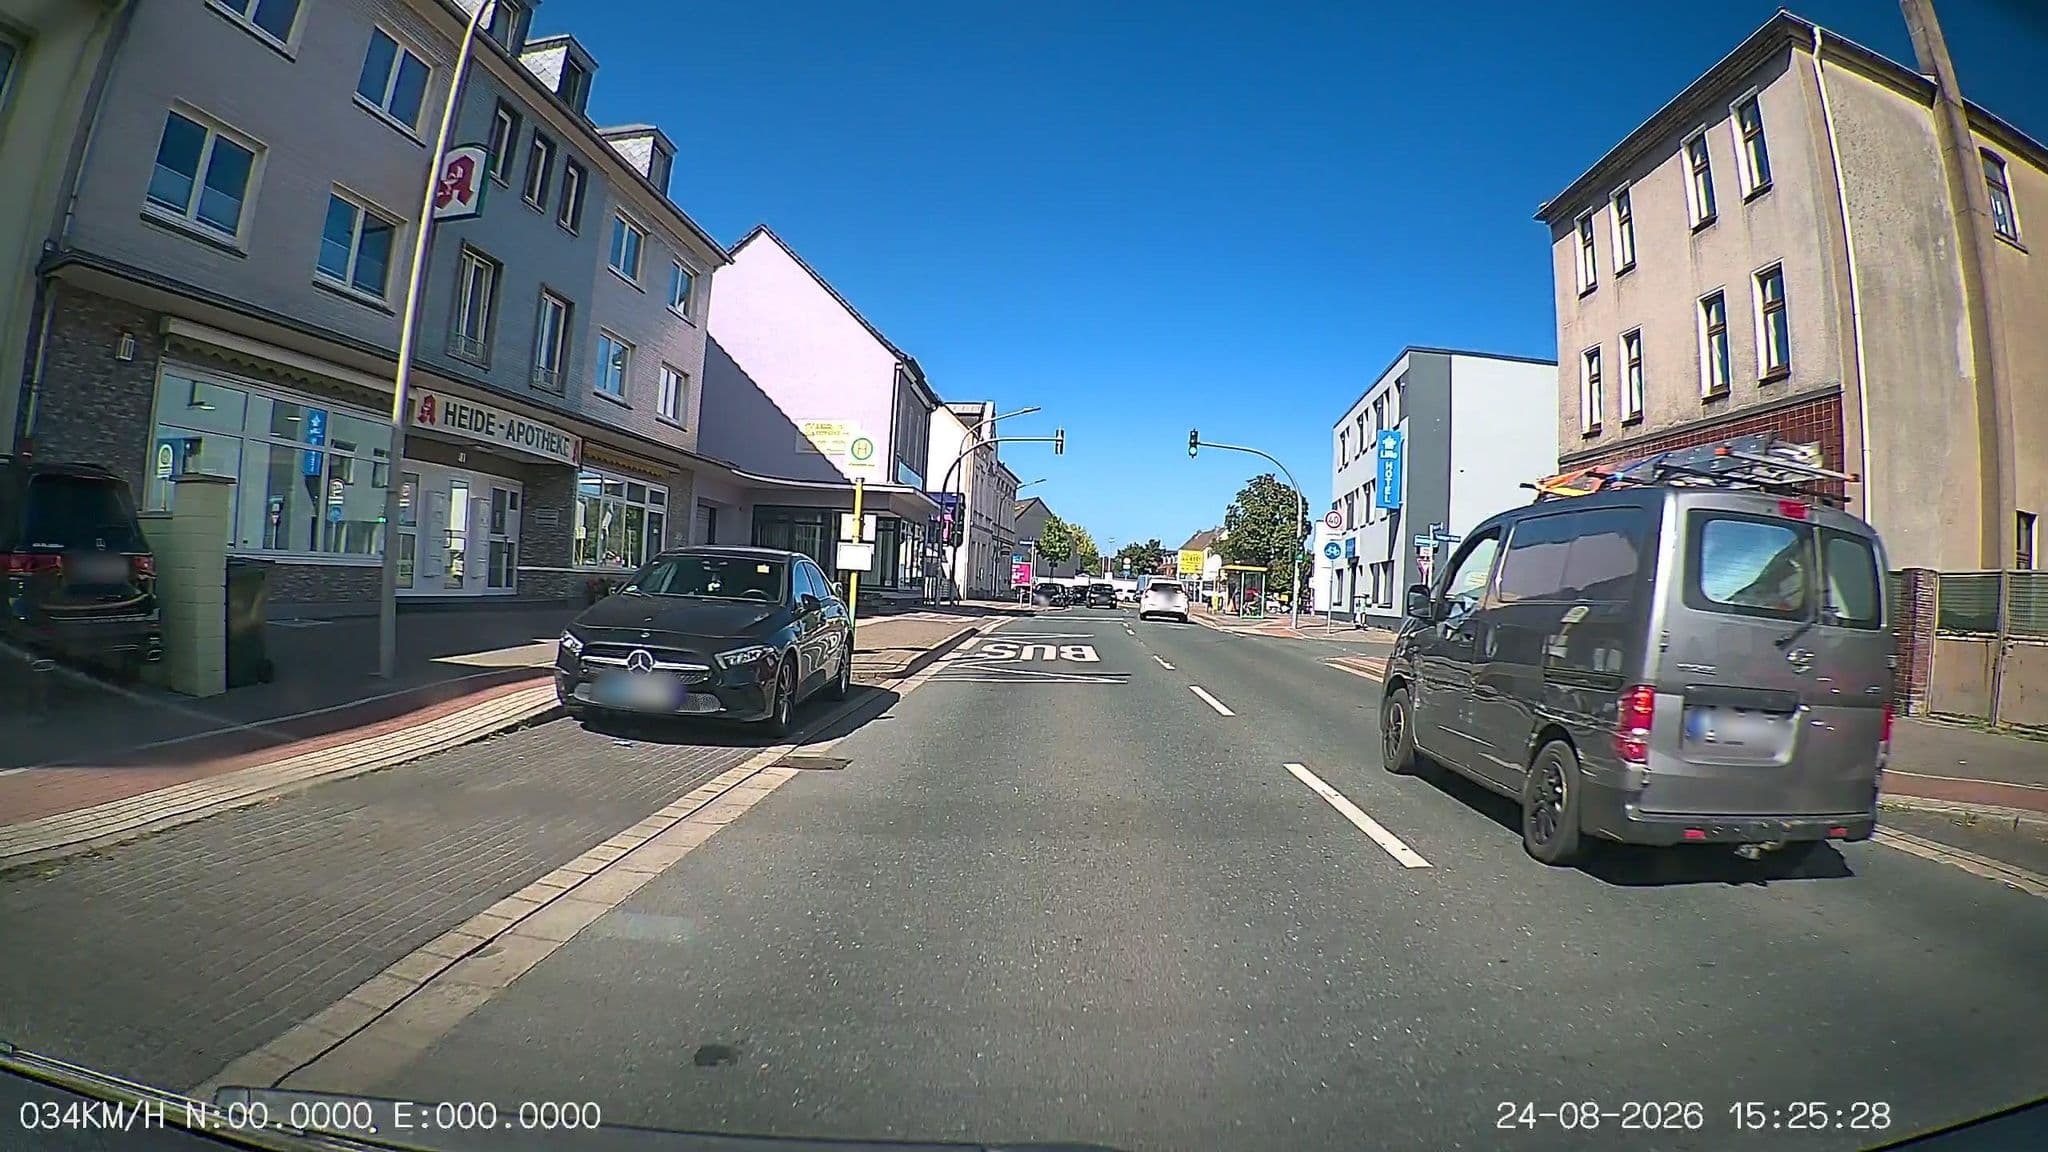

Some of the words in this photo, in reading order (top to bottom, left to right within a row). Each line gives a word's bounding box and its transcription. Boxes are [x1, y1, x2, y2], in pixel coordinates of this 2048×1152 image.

[1384, 461, 1394, 504] HOTEL
[1328, 515, 1339, 525] 40
[978, 644, 1100, 662] BUS
